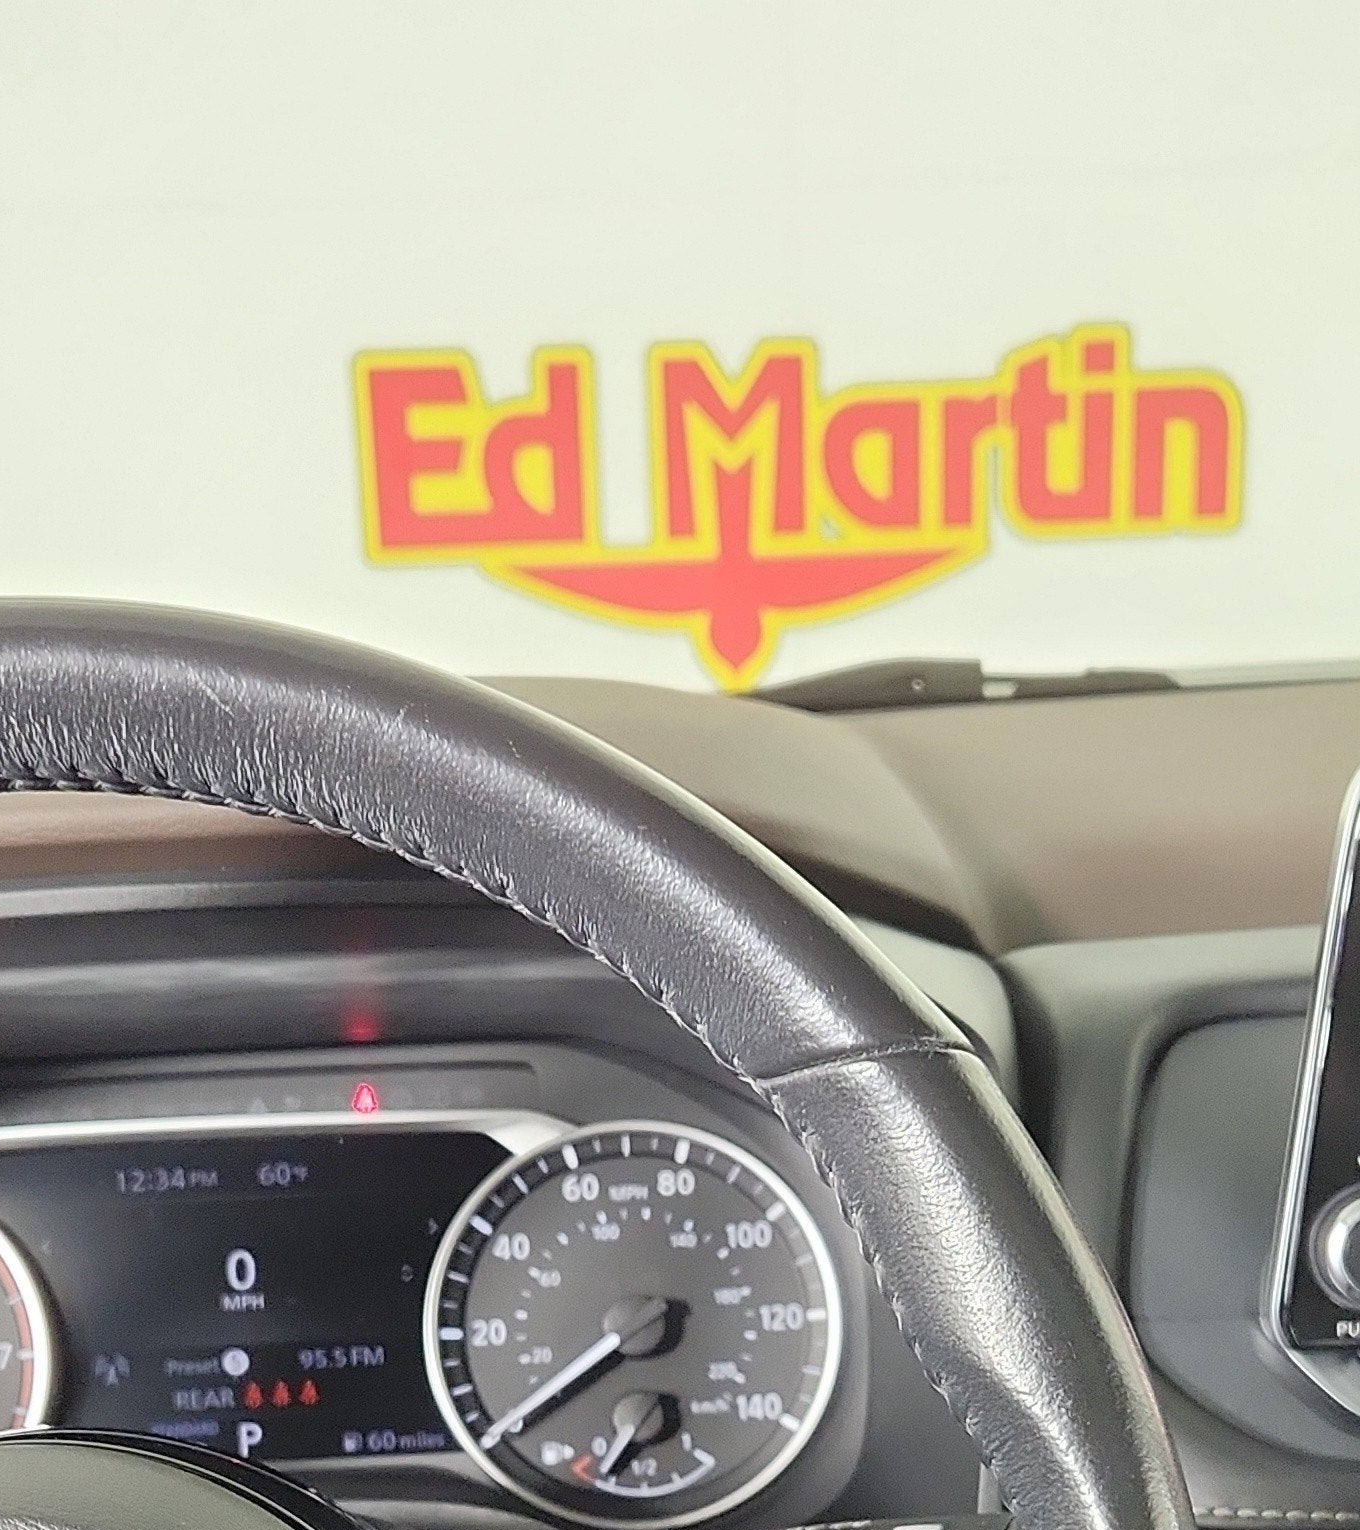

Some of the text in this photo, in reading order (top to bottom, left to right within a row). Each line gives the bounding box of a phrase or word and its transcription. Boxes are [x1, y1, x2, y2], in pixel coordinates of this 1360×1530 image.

[357, 321, 1244, 563] Ed Martin
[116, 1165, 186, 1193] 12:34
[561, 1173, 599, 1201] 60
[656, 1168, 695, 1196] 80
[492, 1232, 531, 1261] 40
[725, 1219, 773, 1249] 100
[225, 1249, 257, 1292] 0
[219, 1294, 265, 1311] MPH
[759, 1302, 805, 1332] 120
[471, 1318, 507, 1346] 20
[349, 1345, 385, 1368] FM
[175, 1387, 235, 1411] REAR
[735, 1392, 783, 1421] 140
[237, 1421, 263, 1458] P
[367, 1429, 396, 1451] 60
